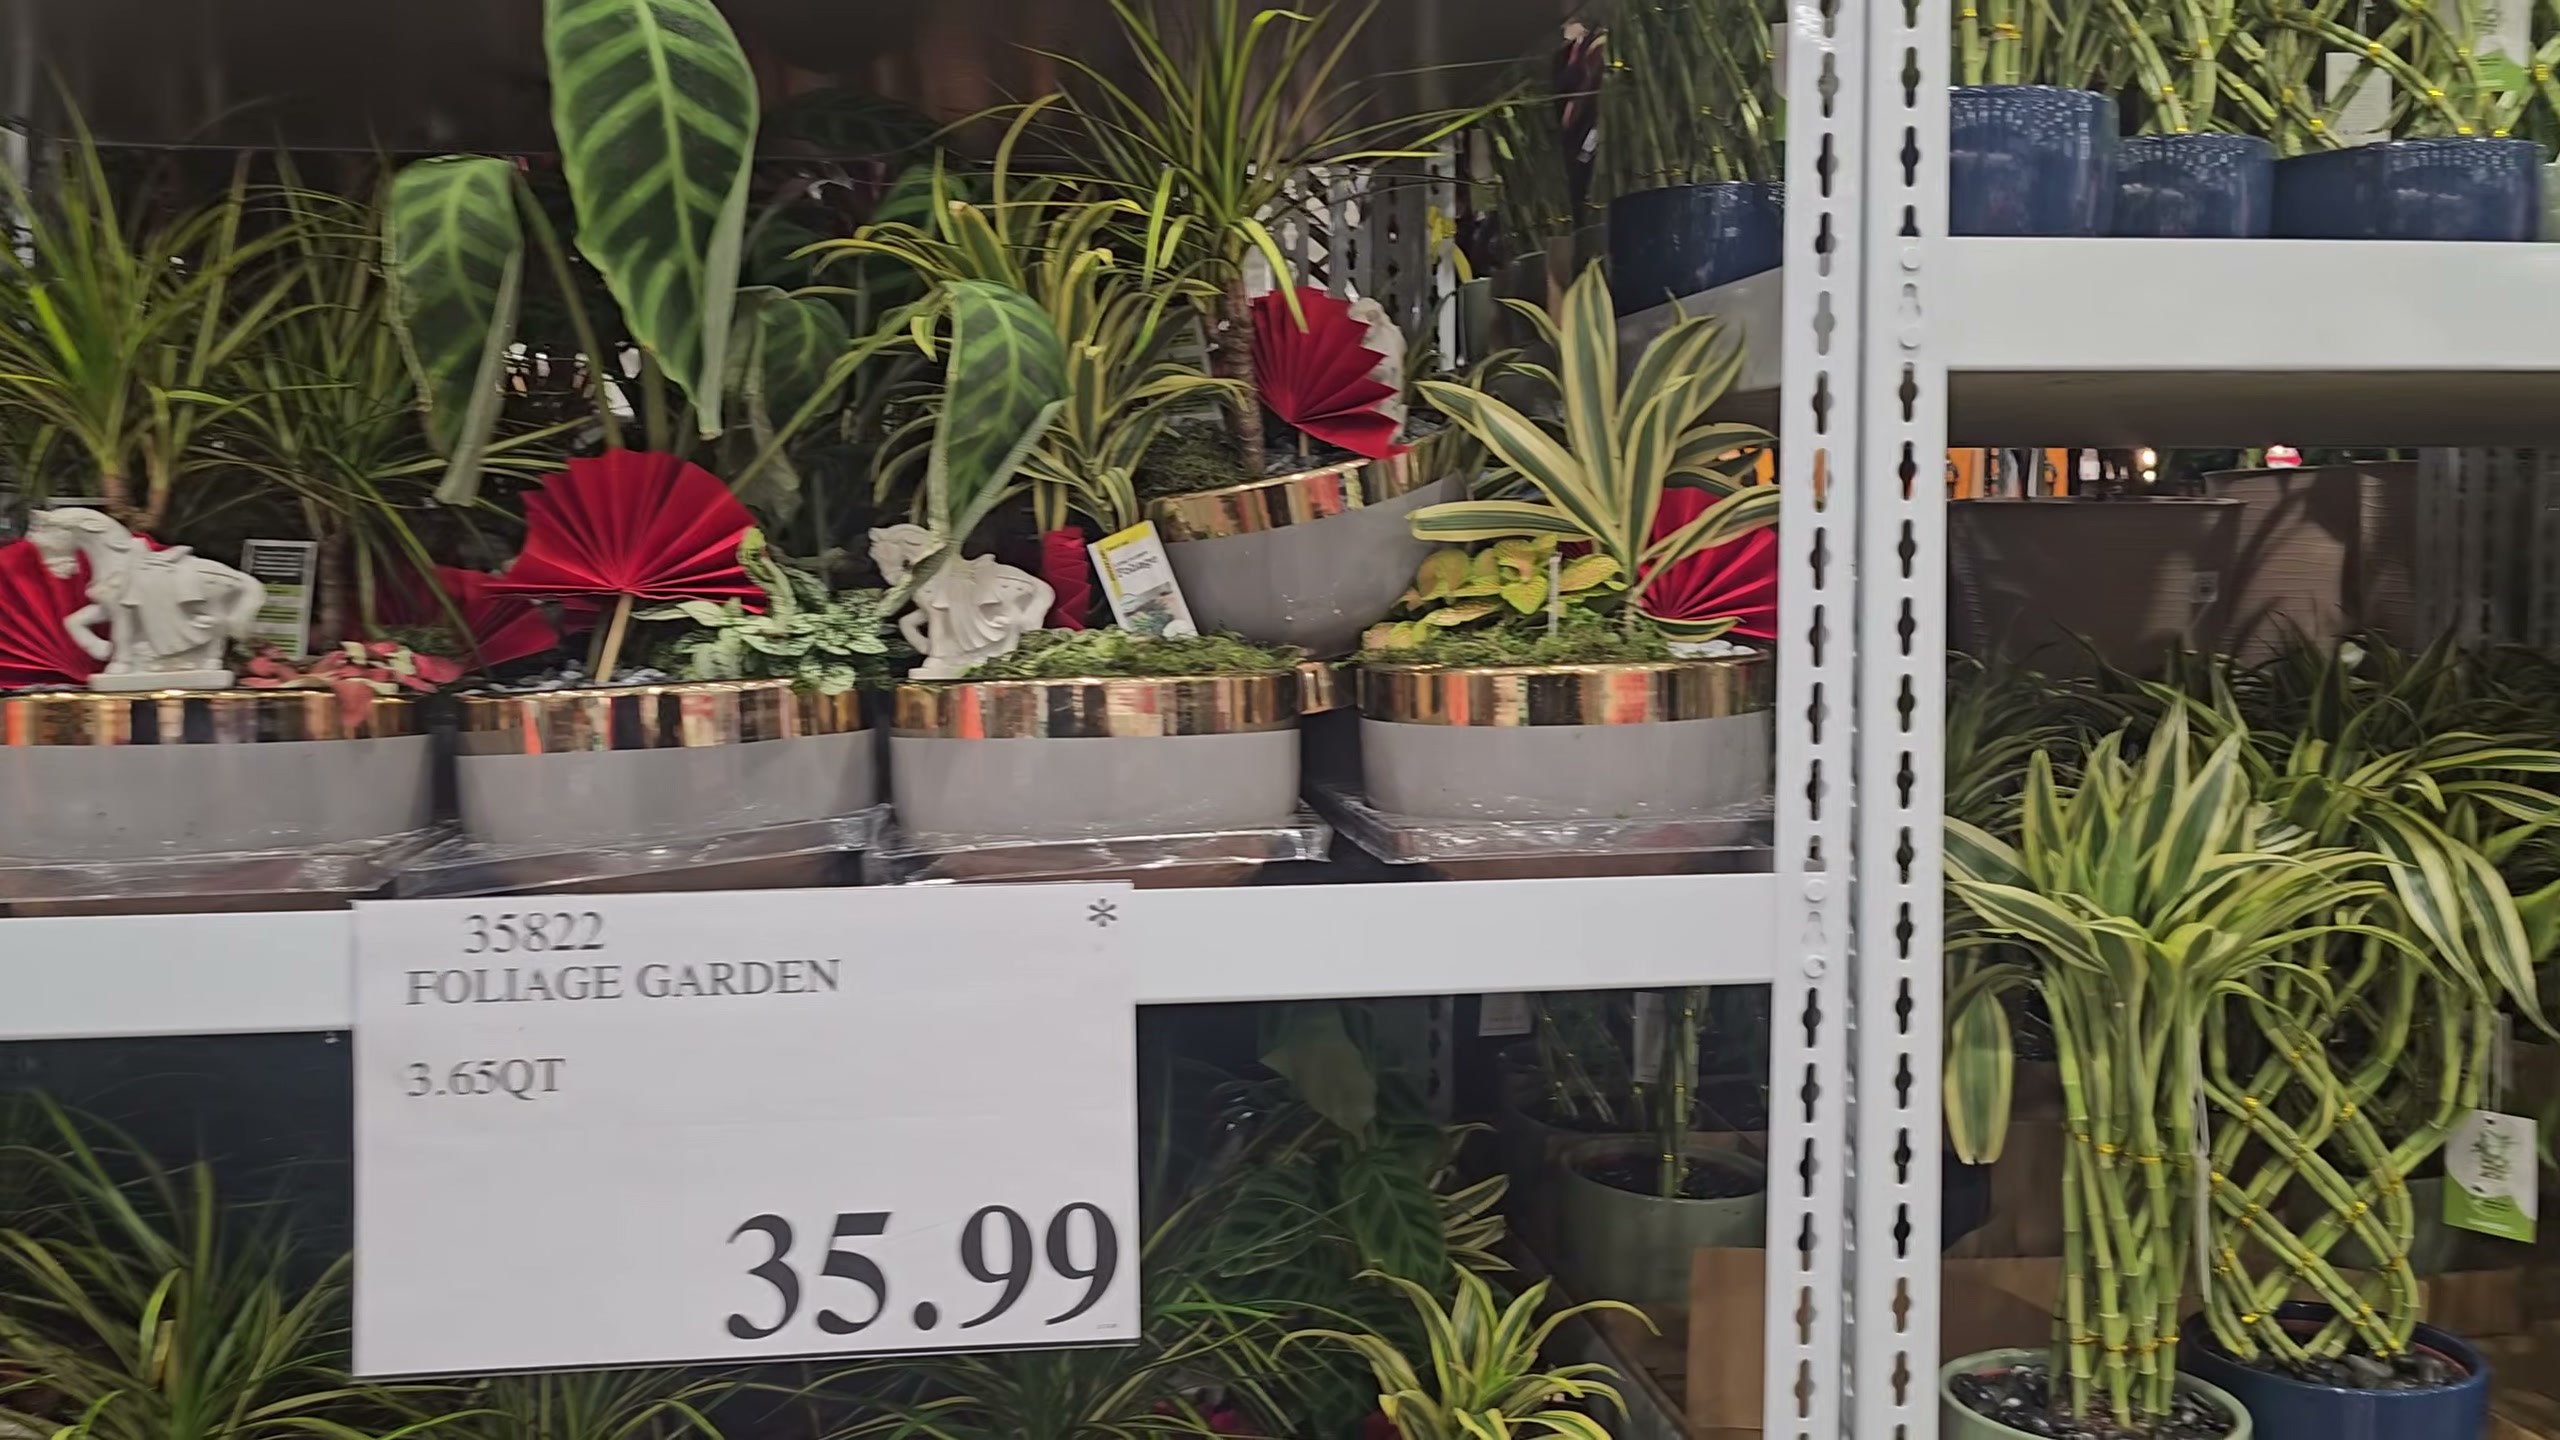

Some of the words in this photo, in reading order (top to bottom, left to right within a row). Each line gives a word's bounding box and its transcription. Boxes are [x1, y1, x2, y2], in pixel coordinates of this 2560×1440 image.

[464, 911, 605, 954] 35822
[404, 965, 623, 1006] FOLIAGE
[635, 958, 841, 999] GARDEN
[406, 1057, 566, 1101] 3.65QT
[725, 1201, 1119, 1341] 35.99
